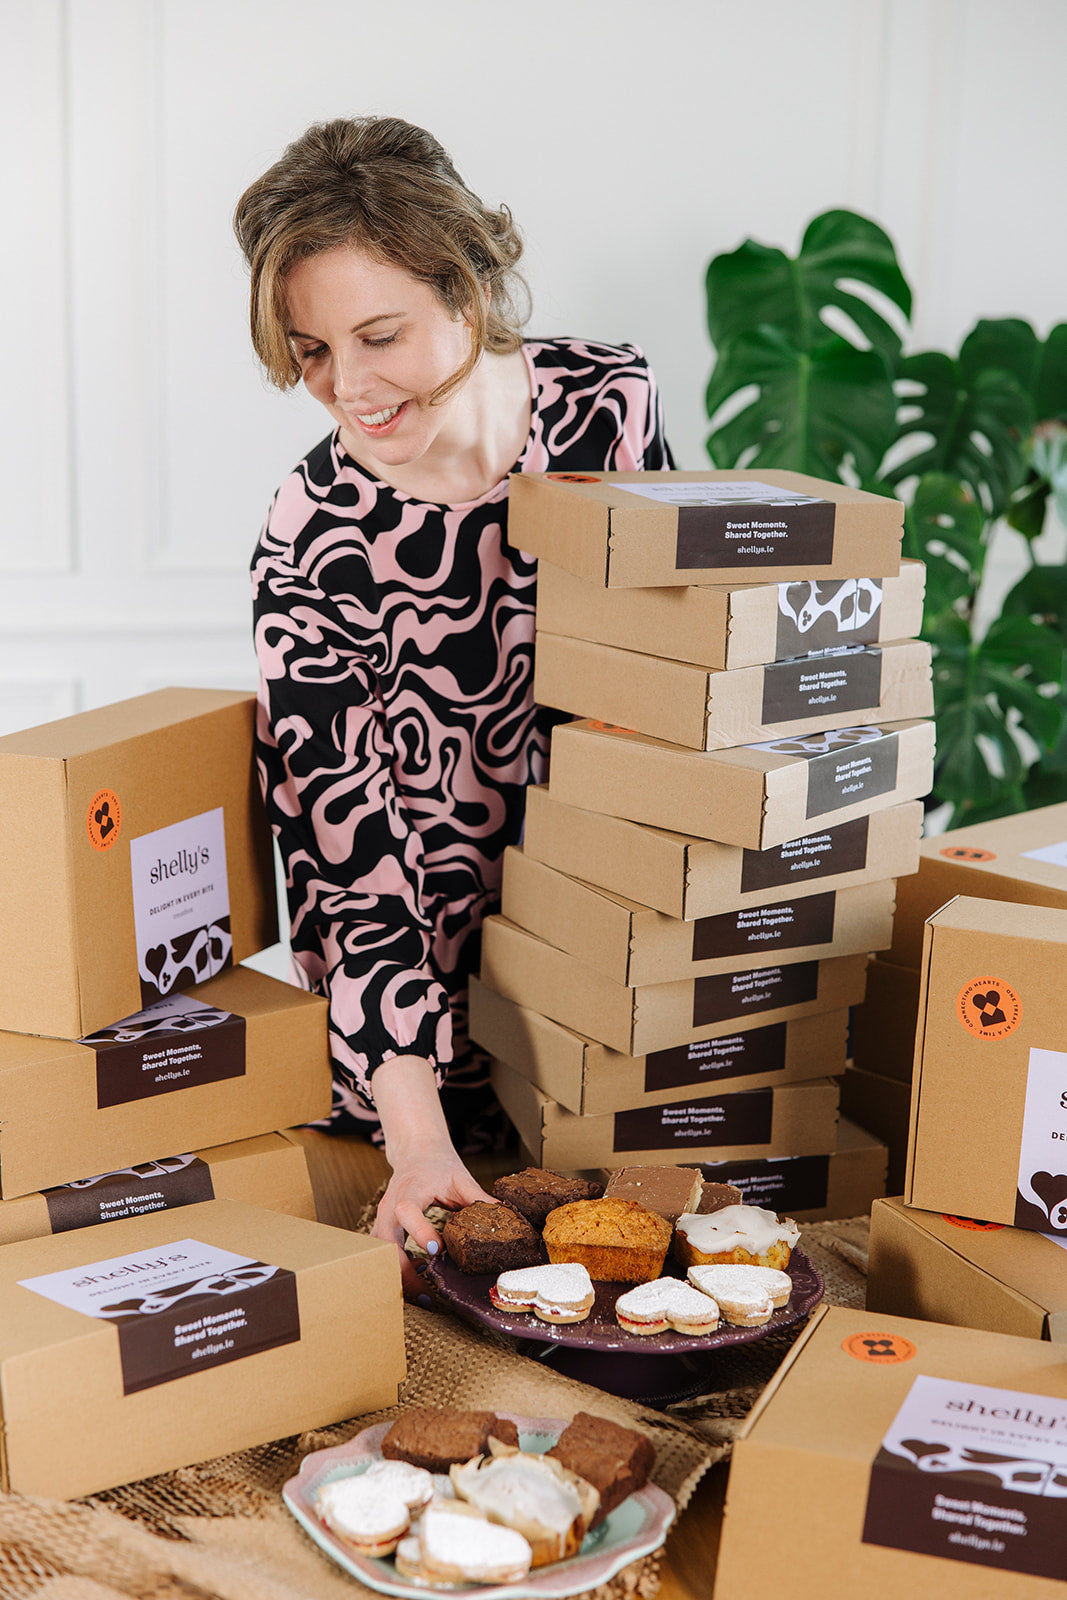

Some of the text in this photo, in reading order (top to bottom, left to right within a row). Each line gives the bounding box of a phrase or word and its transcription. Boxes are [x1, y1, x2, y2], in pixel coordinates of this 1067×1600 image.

[726, 521, 788, 530] Sweet Moments,
[725, 530, 789, 540] Shared Together.
[800, 673, 819, 682] Sweet
[799, 682, 820, 692] Shared
[836, 762, 850, 773] Sweet
[835, 771, 851, 783] Shared
[782, 834, 832, 850] Sweet Moments,
[780, 843, 832, 859] Shared Together.
[150, 846, 210, 885] shelly's
[149, 900, 174, 916] DELIGHT
[175, 897, 182, 906] IN
[183, 890, 201, 904] EVERY
[202, 884, 214, 896] BITE
[738, 906, 794, 920] Sweet Moments,
[736, 915, 794, 929] Shared Together.
[732, 967, 782, 984] Sweet Moments,
[731, 976, 783, 993] Shared Together.
[1006, 989, 1016, 1001] ONE
[689, 1036, 745, 1051] Sweet Moments,
[143, 1043, 202, 1062] Sweet Moments,
[687, 1045, 745, 1060] Shared Together.
[142, 1053, 203, 1071] Shared Together.
[662, 1106, 725, 1116] Sweet Moments,
[661, 1114, 726, 1125] Shared Together.
[99, 1192, 165, 1210] Sweet Moments,
[100, 1202, 167, 1220] Shared Together.
[72, 1253, 188, 1289] shelly's
[174, 1307, 246, 1336] Sweet Moments,
[174, 1318, 248, 1348] Shared Together.
[945, 1399, 1067, 1430] shelly'
[934, 1494, 971, 1513] Sweet
[931, 1506, 973, 1526] Shared
